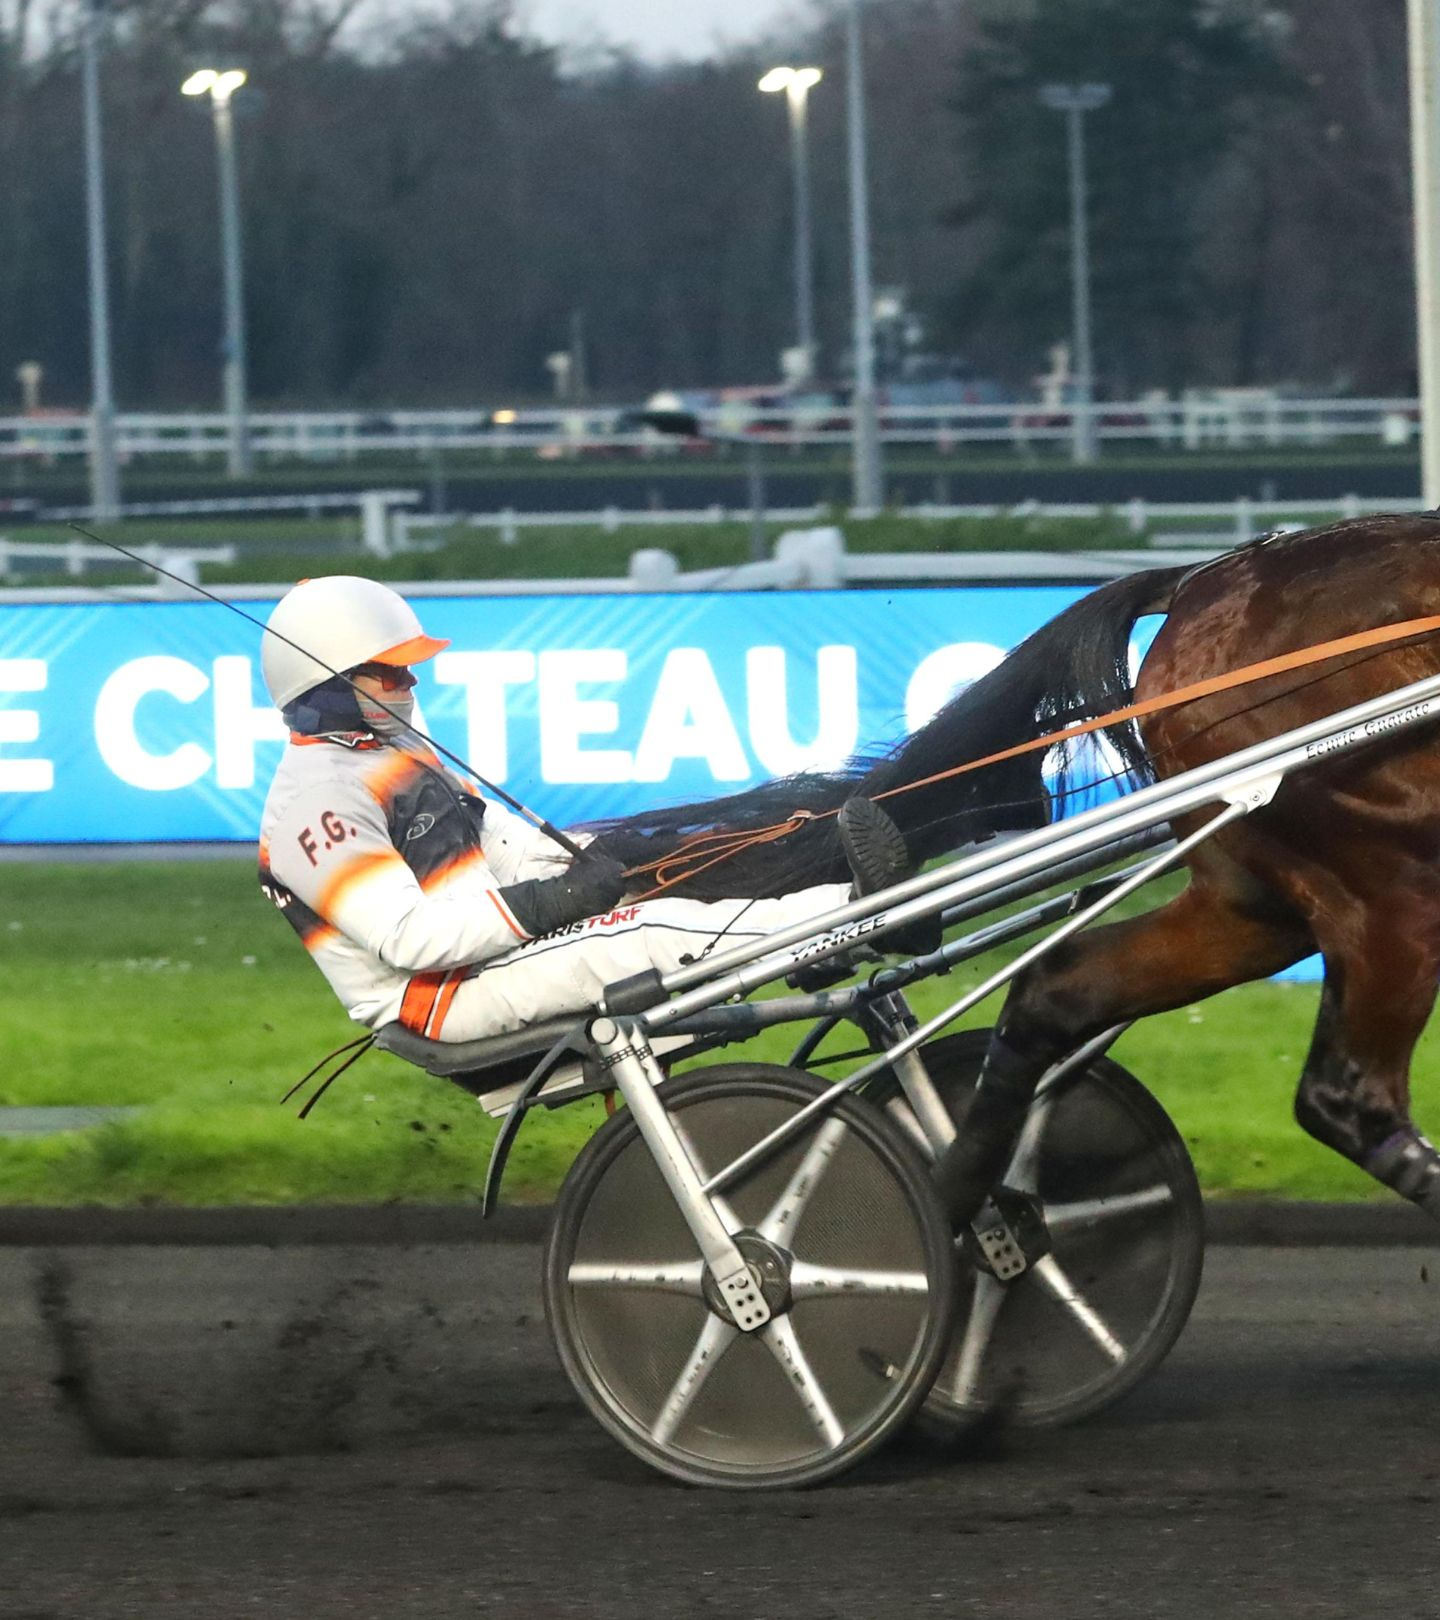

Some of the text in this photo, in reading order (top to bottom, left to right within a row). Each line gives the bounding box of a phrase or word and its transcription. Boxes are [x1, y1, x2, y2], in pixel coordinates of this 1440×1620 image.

[93, 644, 860, 792] CHTEAU
[297, 810, 357, 868] F.G.
[791, 912, 888, 962] YANKEE
